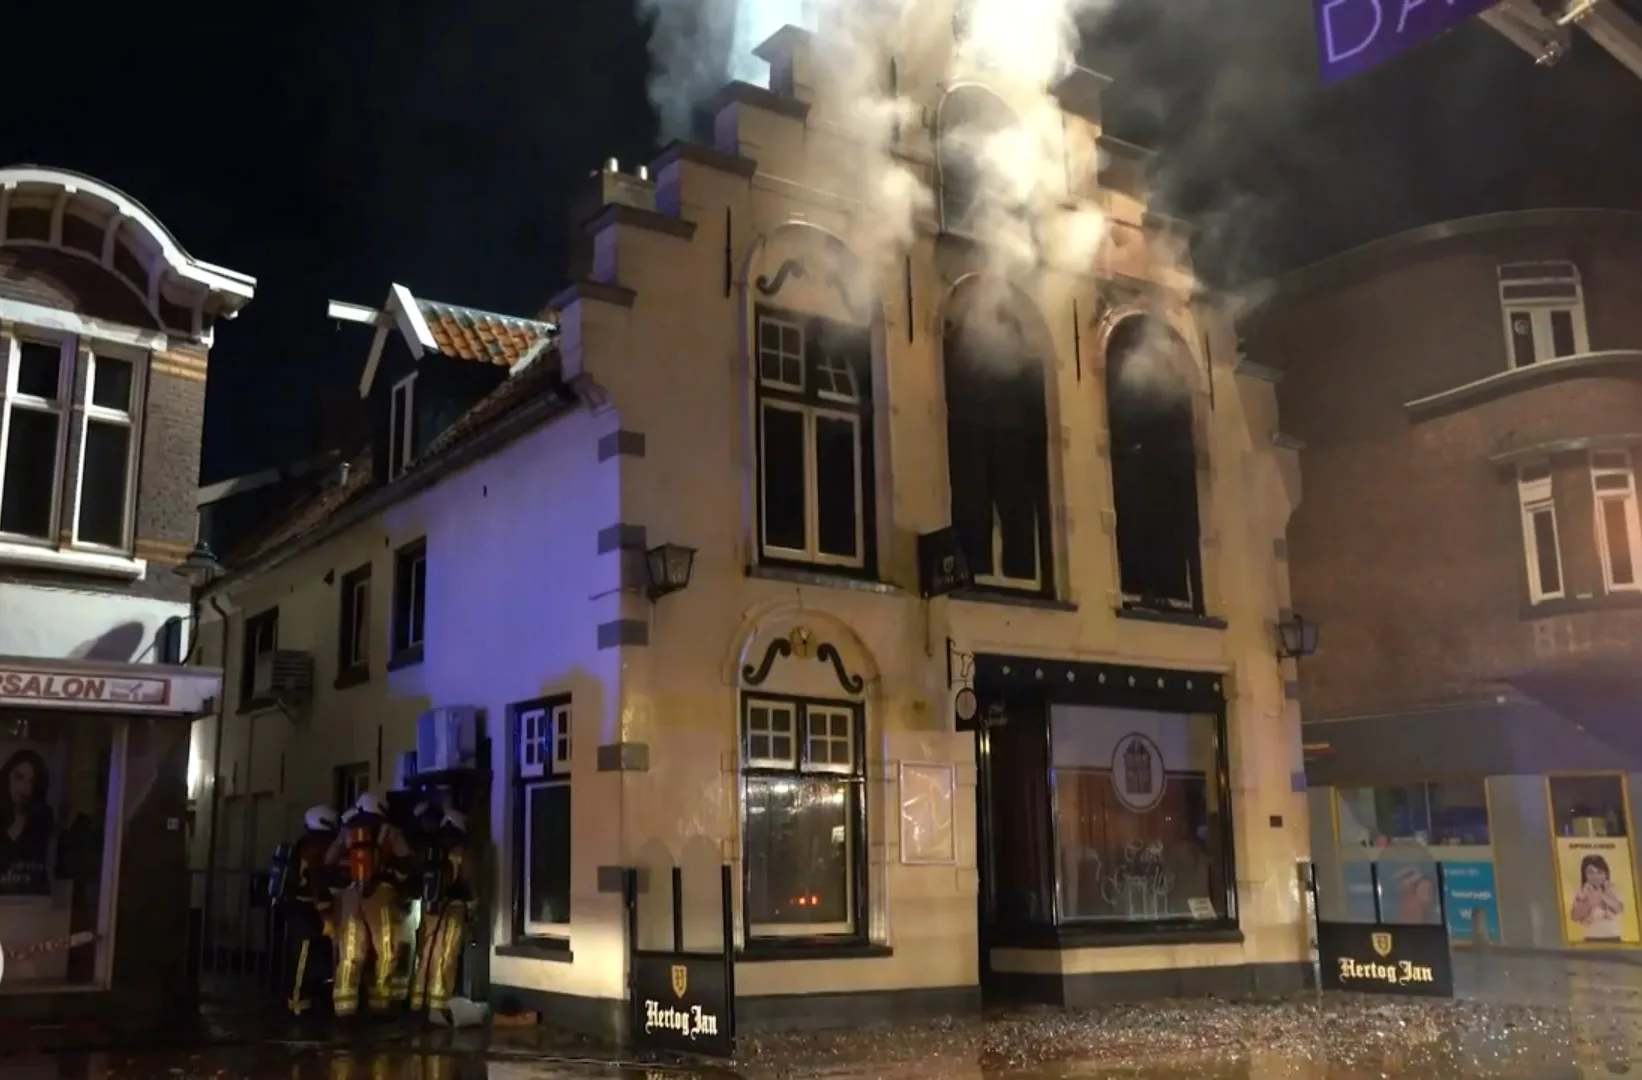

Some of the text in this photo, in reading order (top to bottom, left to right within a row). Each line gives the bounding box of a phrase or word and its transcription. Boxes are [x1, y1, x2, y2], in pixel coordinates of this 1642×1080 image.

[0, 674, 105, 698] SALON
[1338, 957, 1434, 986] Hertog Jan
[645, 999, 718, 1040] Hertog Jan
